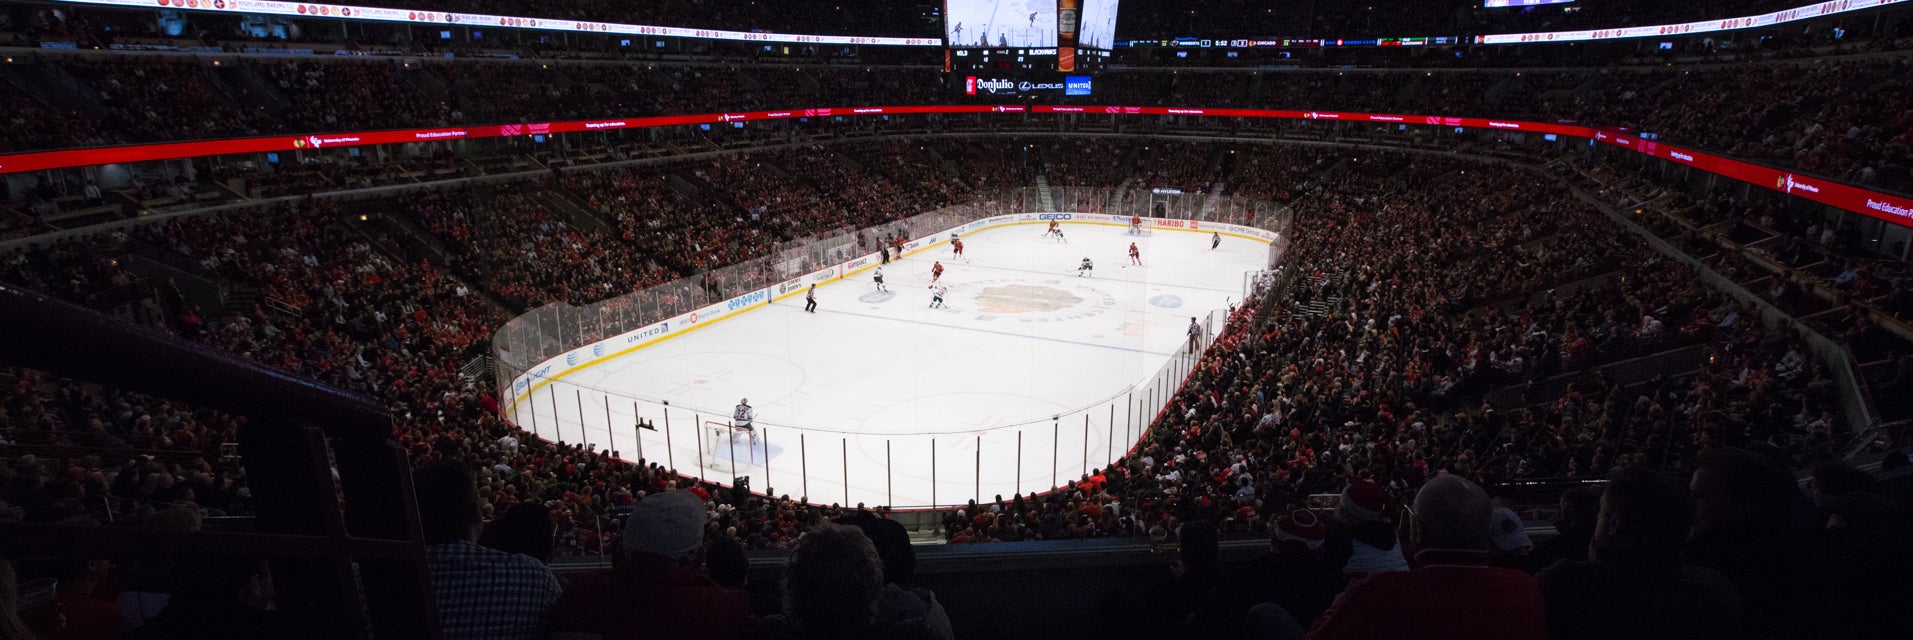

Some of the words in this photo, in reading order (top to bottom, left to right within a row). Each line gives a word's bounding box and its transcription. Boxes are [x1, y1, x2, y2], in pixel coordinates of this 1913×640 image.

[1867, 199, 1883, 210] Proud
[1881, 202, 1909, 217] Education
[1157, 219, 1184, 228] HARIBO
[627, 327, 660, 343] UNITED
